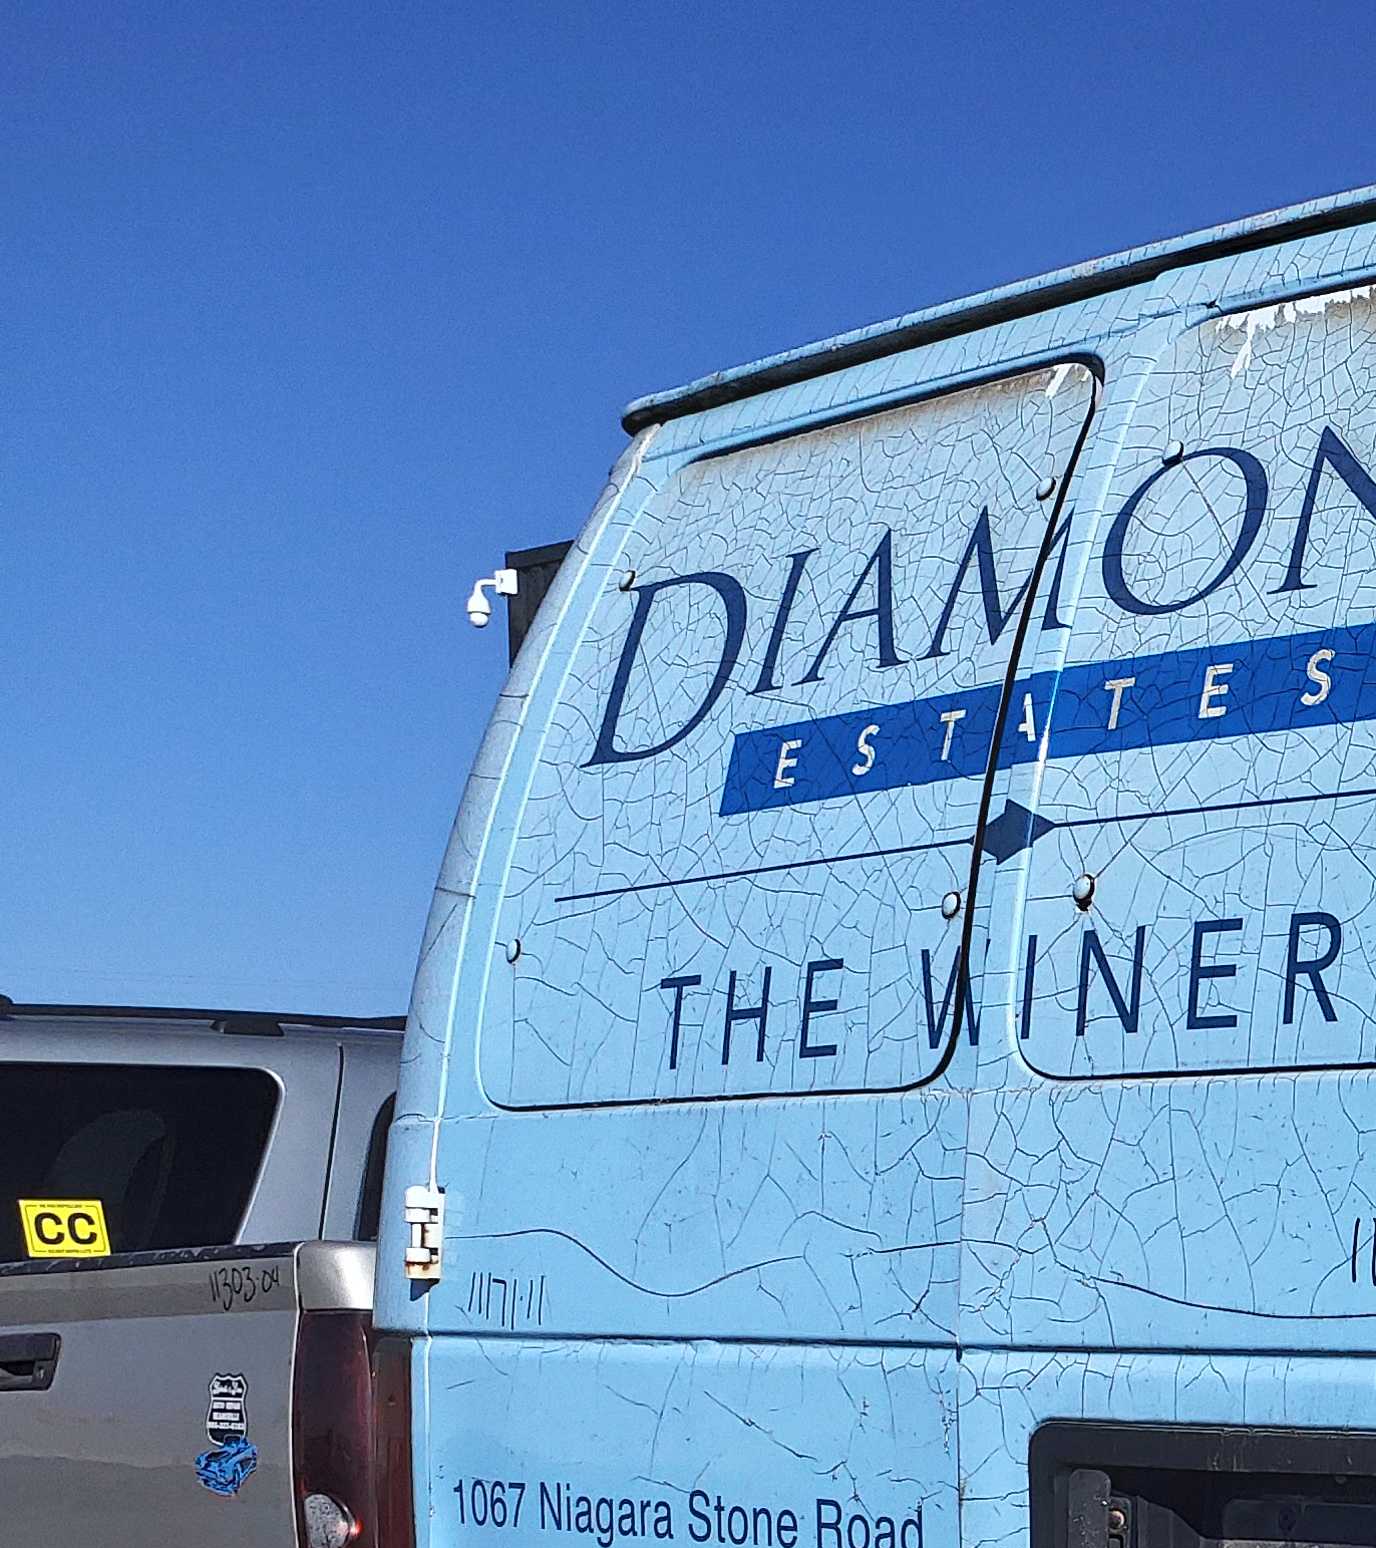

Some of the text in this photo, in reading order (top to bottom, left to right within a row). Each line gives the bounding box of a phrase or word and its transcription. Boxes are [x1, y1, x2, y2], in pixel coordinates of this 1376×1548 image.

[771, 647, 1336, 790] ESTATES
[660, 957, 846, 1071] THE
[34, 1211, 98, 1245] CC
[453, 1479, 526, 1527] 1067
[539, 1481, 674, 1548] Niagara
[688, 1489, 798, 1548] Stone
